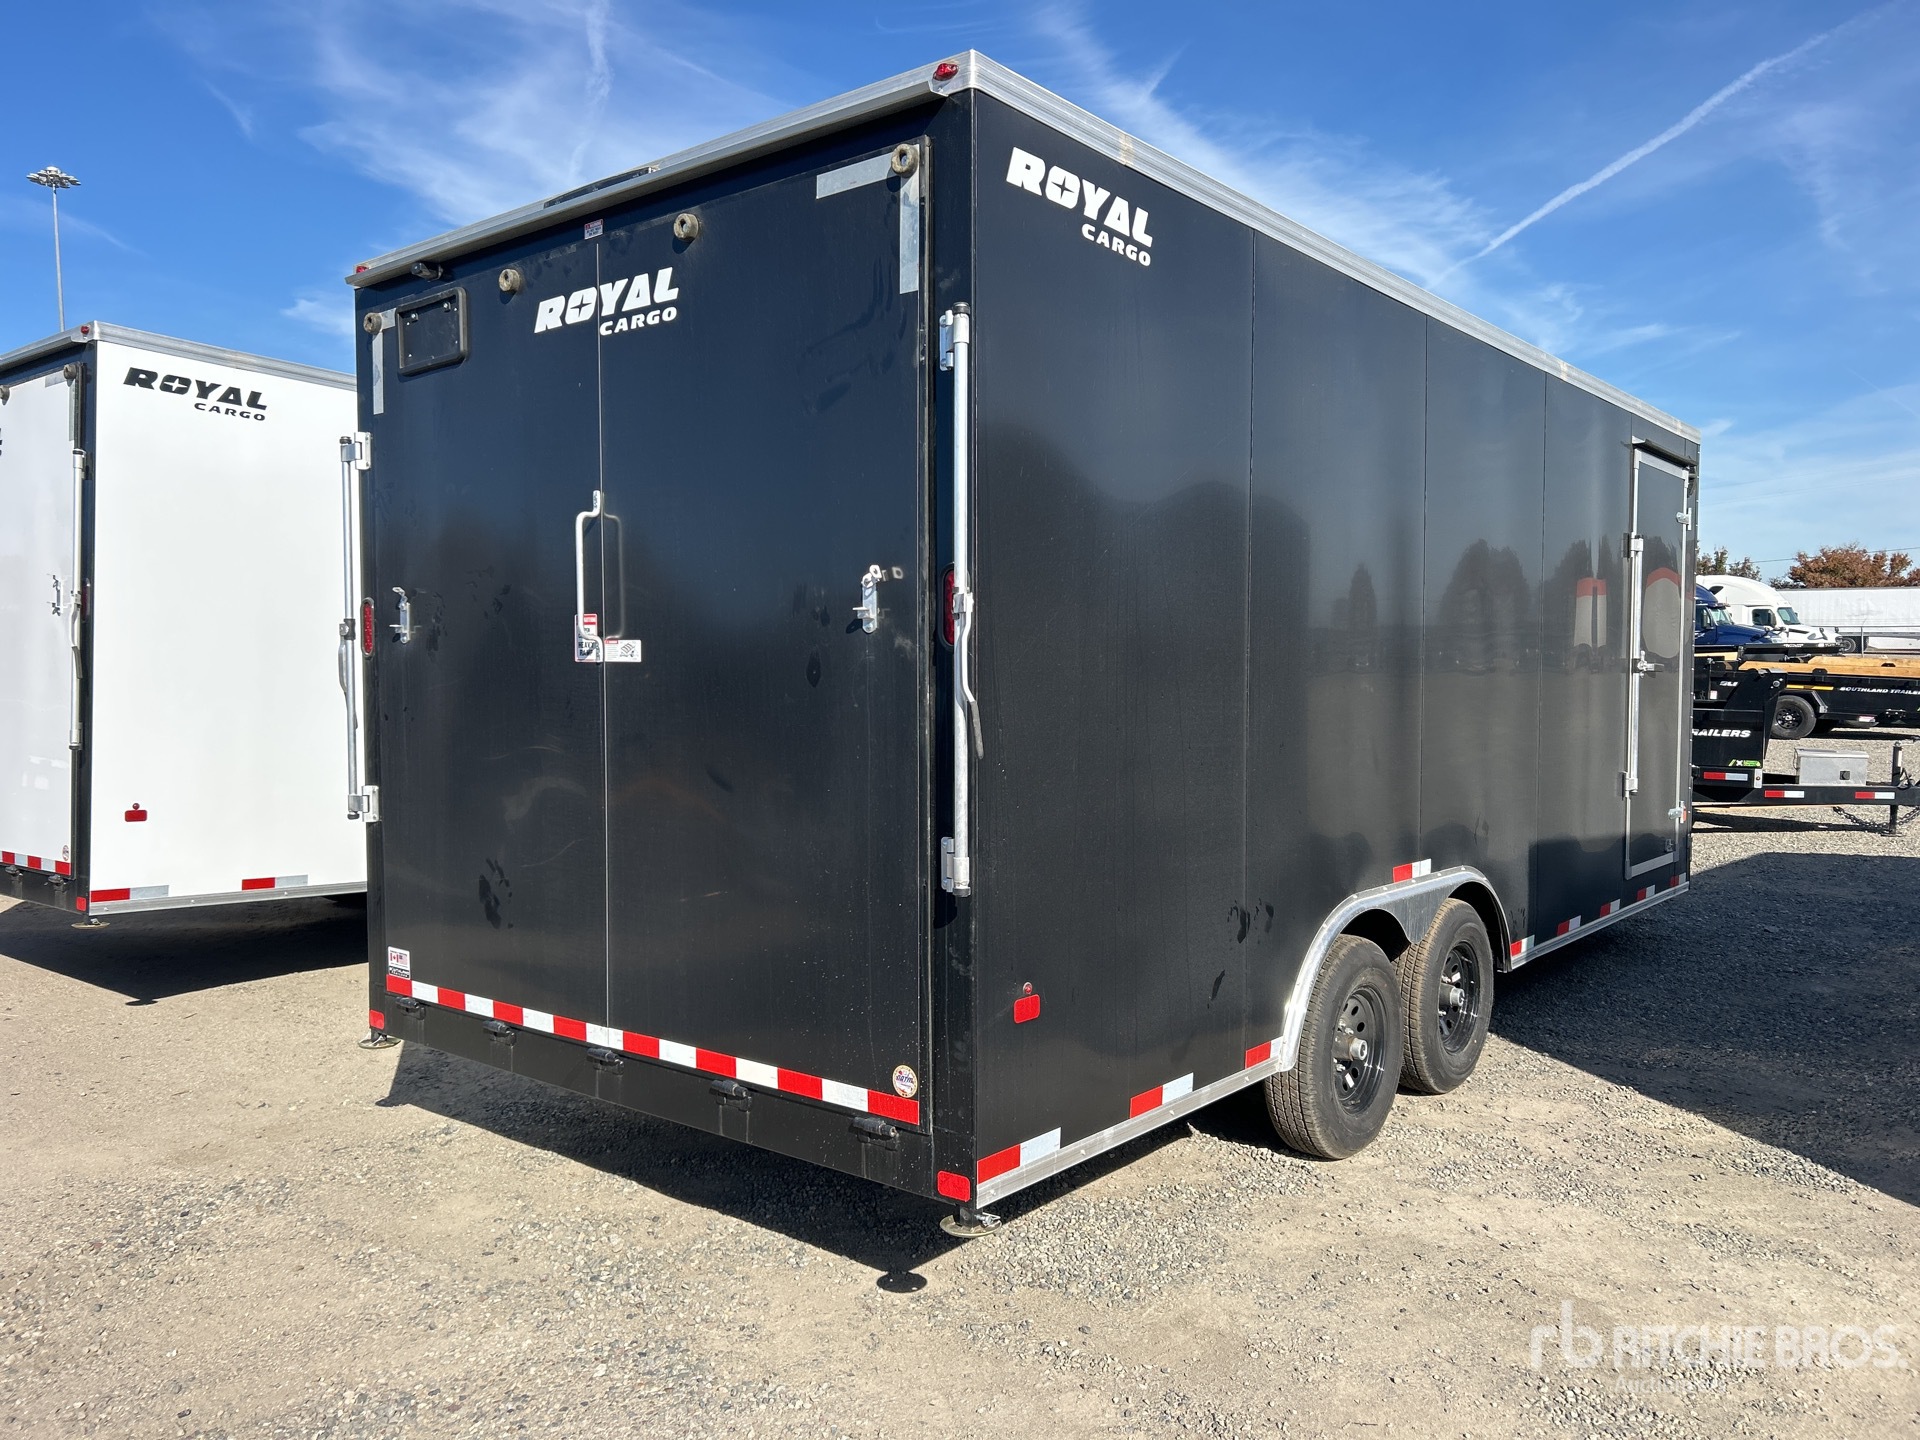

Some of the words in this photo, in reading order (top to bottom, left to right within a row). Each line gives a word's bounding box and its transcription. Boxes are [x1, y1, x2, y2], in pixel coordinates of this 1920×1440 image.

[1006, 146, 1153, 248] ROYAL
[1081, 223, 1151, 267] CARGO
[533, 266, 680, 334] ROYAL
[599, 306, 678, 336] CARGO
[123, 367, 268, 411] ROYAL
[194, 402, 266, 421] CARGO
[1691, 728, 1752, 738] RAILERS
